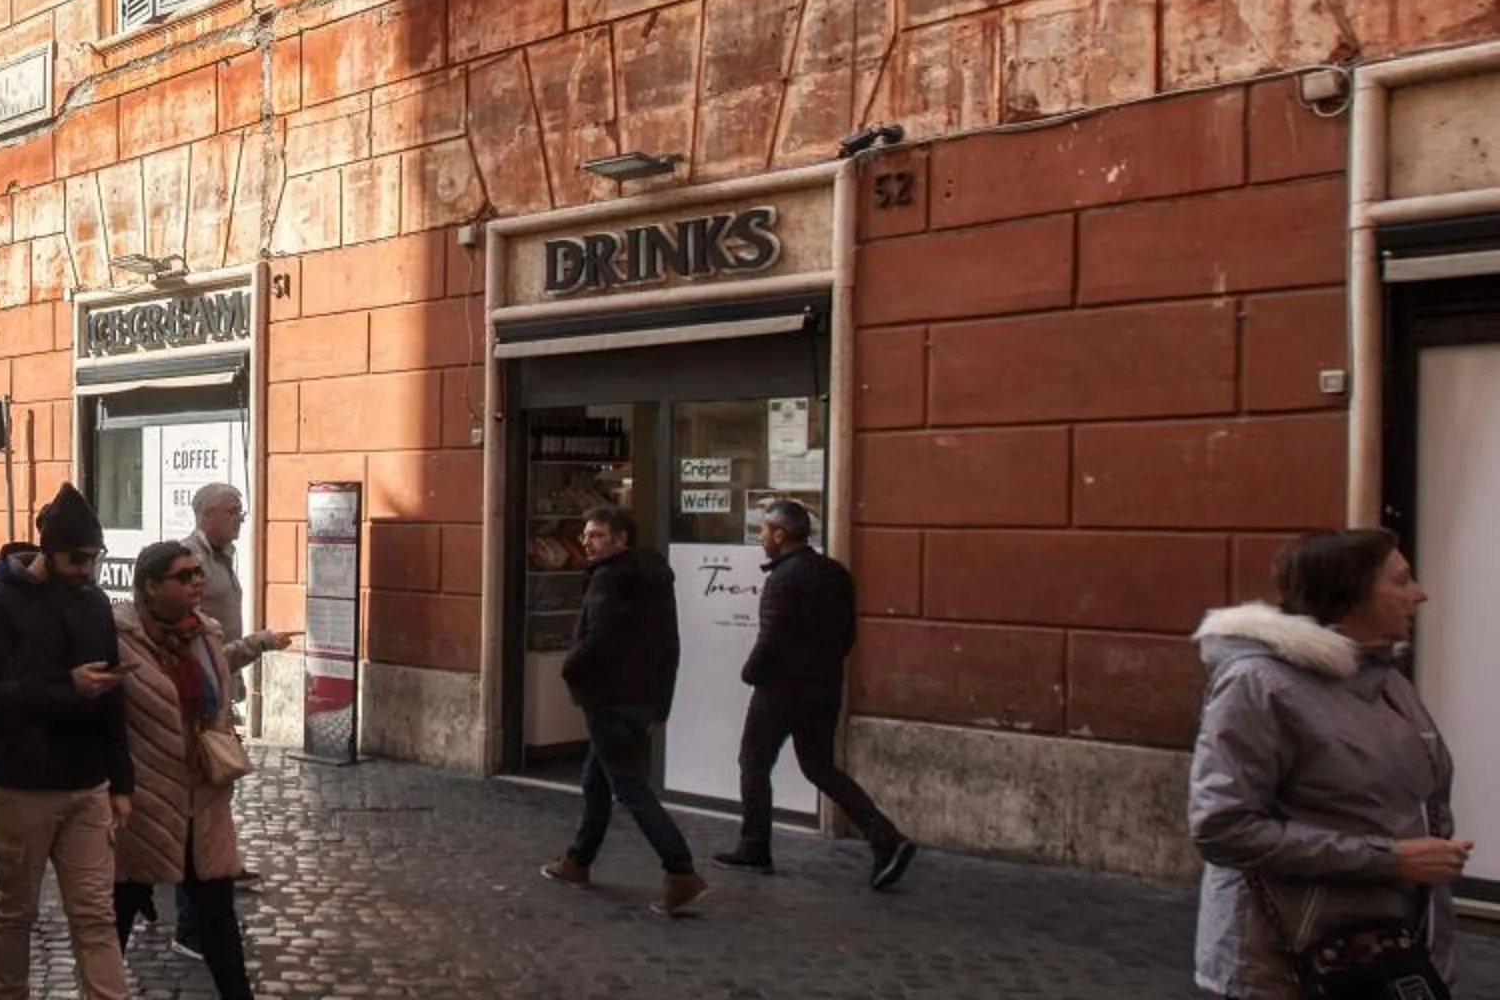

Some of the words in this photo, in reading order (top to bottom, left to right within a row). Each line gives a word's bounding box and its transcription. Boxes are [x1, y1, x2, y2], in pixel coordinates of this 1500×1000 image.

[874, 171, 914, 209] 52
[545, 206, 781, 294] DRINKS
[173, 450, 219, 471] COFFEE
[682, 461, 730, 480] Crêpes
[683, 493, 729, 512] Waffel
